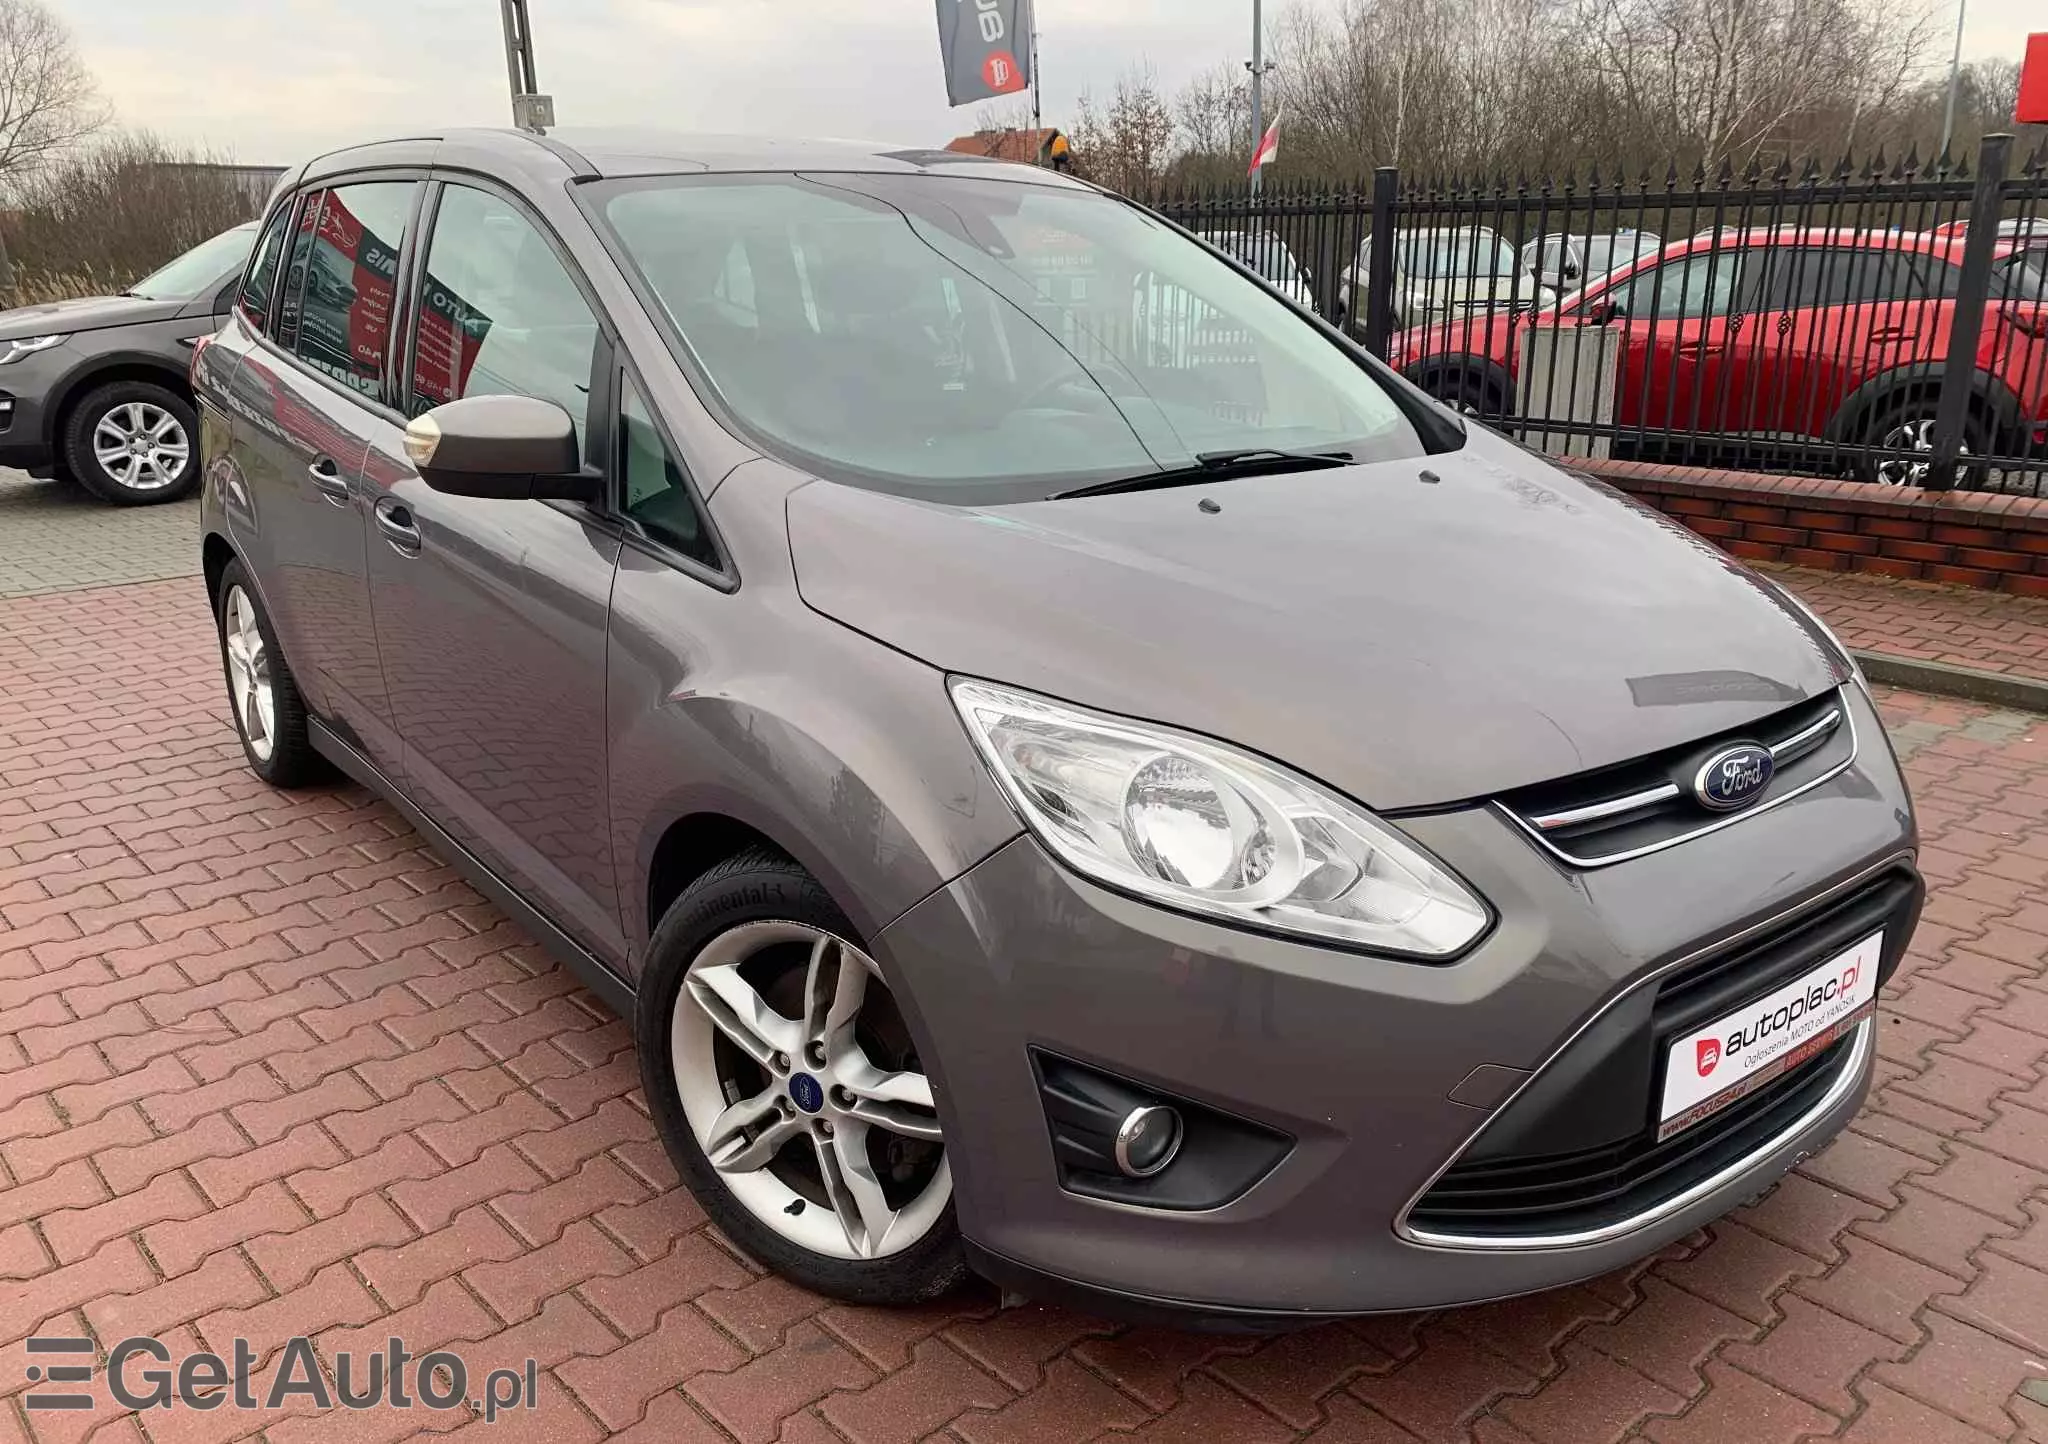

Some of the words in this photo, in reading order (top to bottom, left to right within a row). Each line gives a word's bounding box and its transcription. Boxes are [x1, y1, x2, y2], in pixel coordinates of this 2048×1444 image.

[1721, 755, 1763, 796] Ford
[1725, 955, 1861, 1057] autoplac.pl
[1790, 1020, 1815, 1041] MOTO
